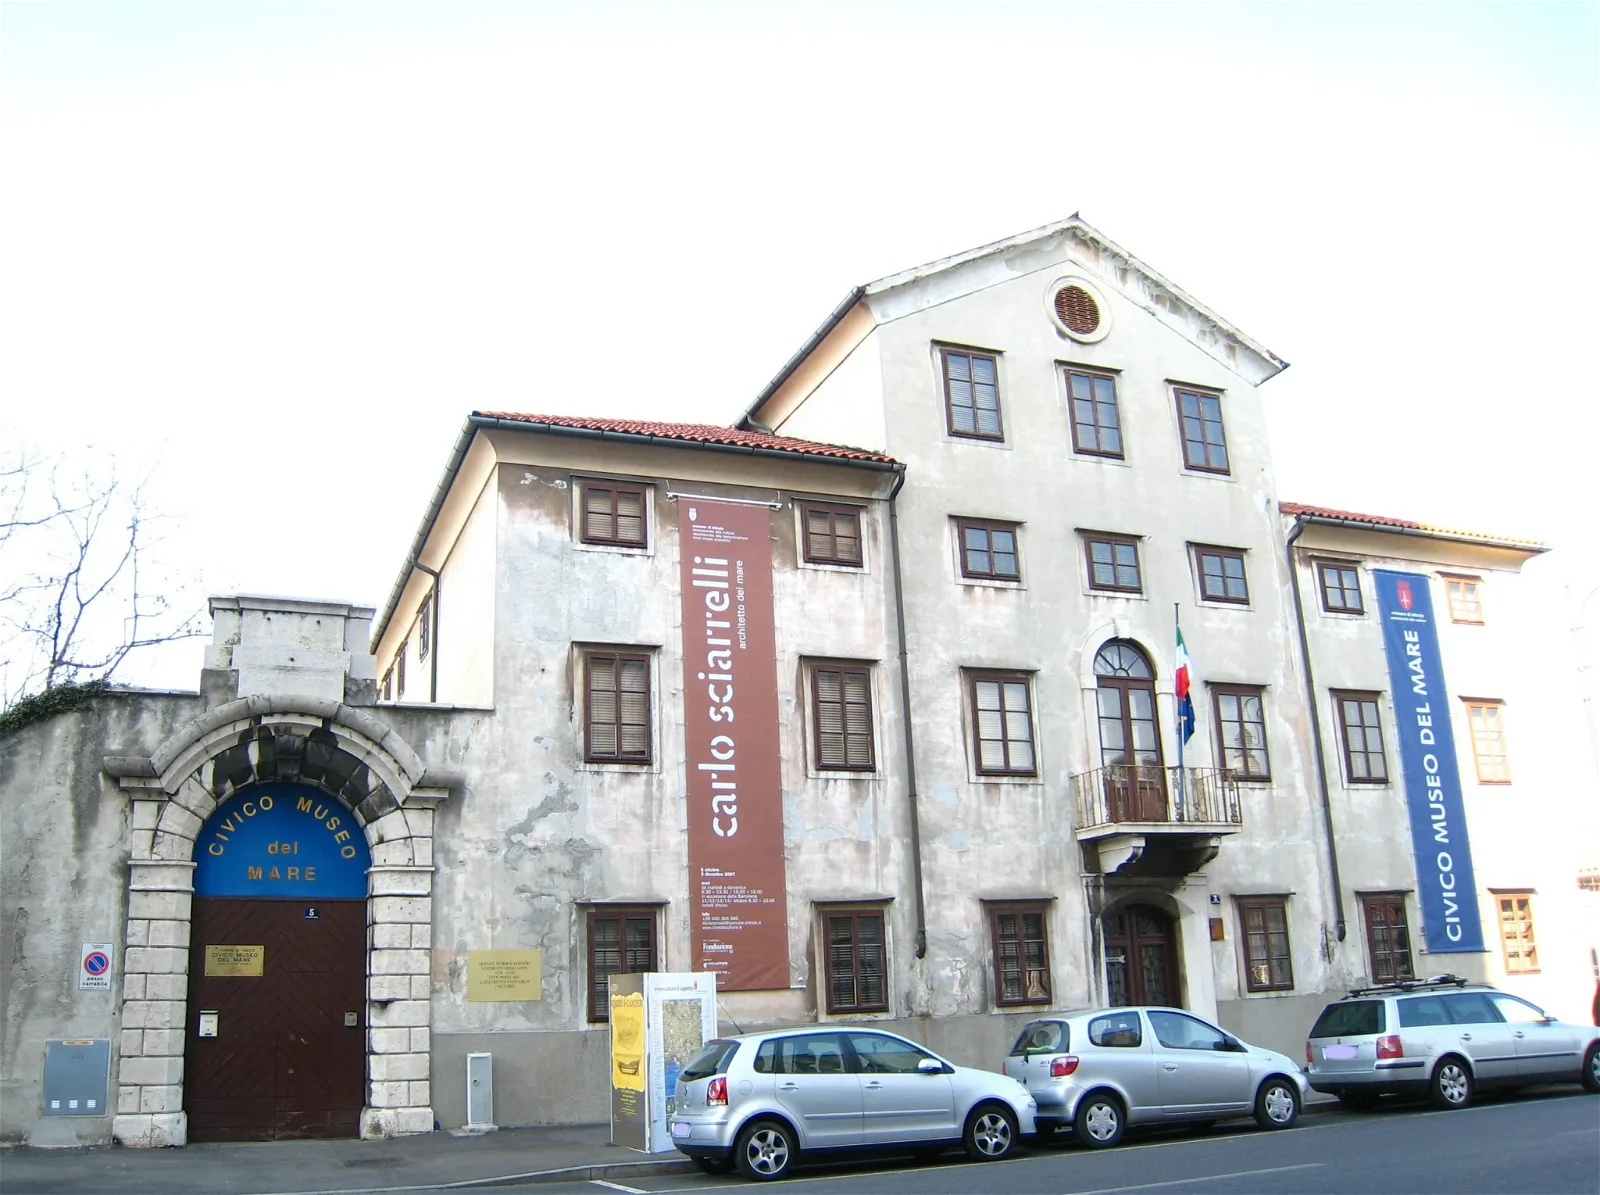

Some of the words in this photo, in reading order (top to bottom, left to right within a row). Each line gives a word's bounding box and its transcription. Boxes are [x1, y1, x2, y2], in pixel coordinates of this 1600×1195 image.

[736, 587, 745, 601] del
[692, 556, 734, 723] sciarrelli
[737, 604, 746, 649] architetto
[1404, 629, 1425, 696] MARE
[1417, 701, 1435, 746] DEL
[698, 735, 738, 837] carlo
[1424, 754, 1449, 844] MUSEO
[209, 796, 273, 856] CIVICO
[296, 796, 356, 859] MUSEO
[267, 840, 298, 854] del
[248, 866, 316, 881] MARE
[1437, 851, 1462, 942] CIVICO
